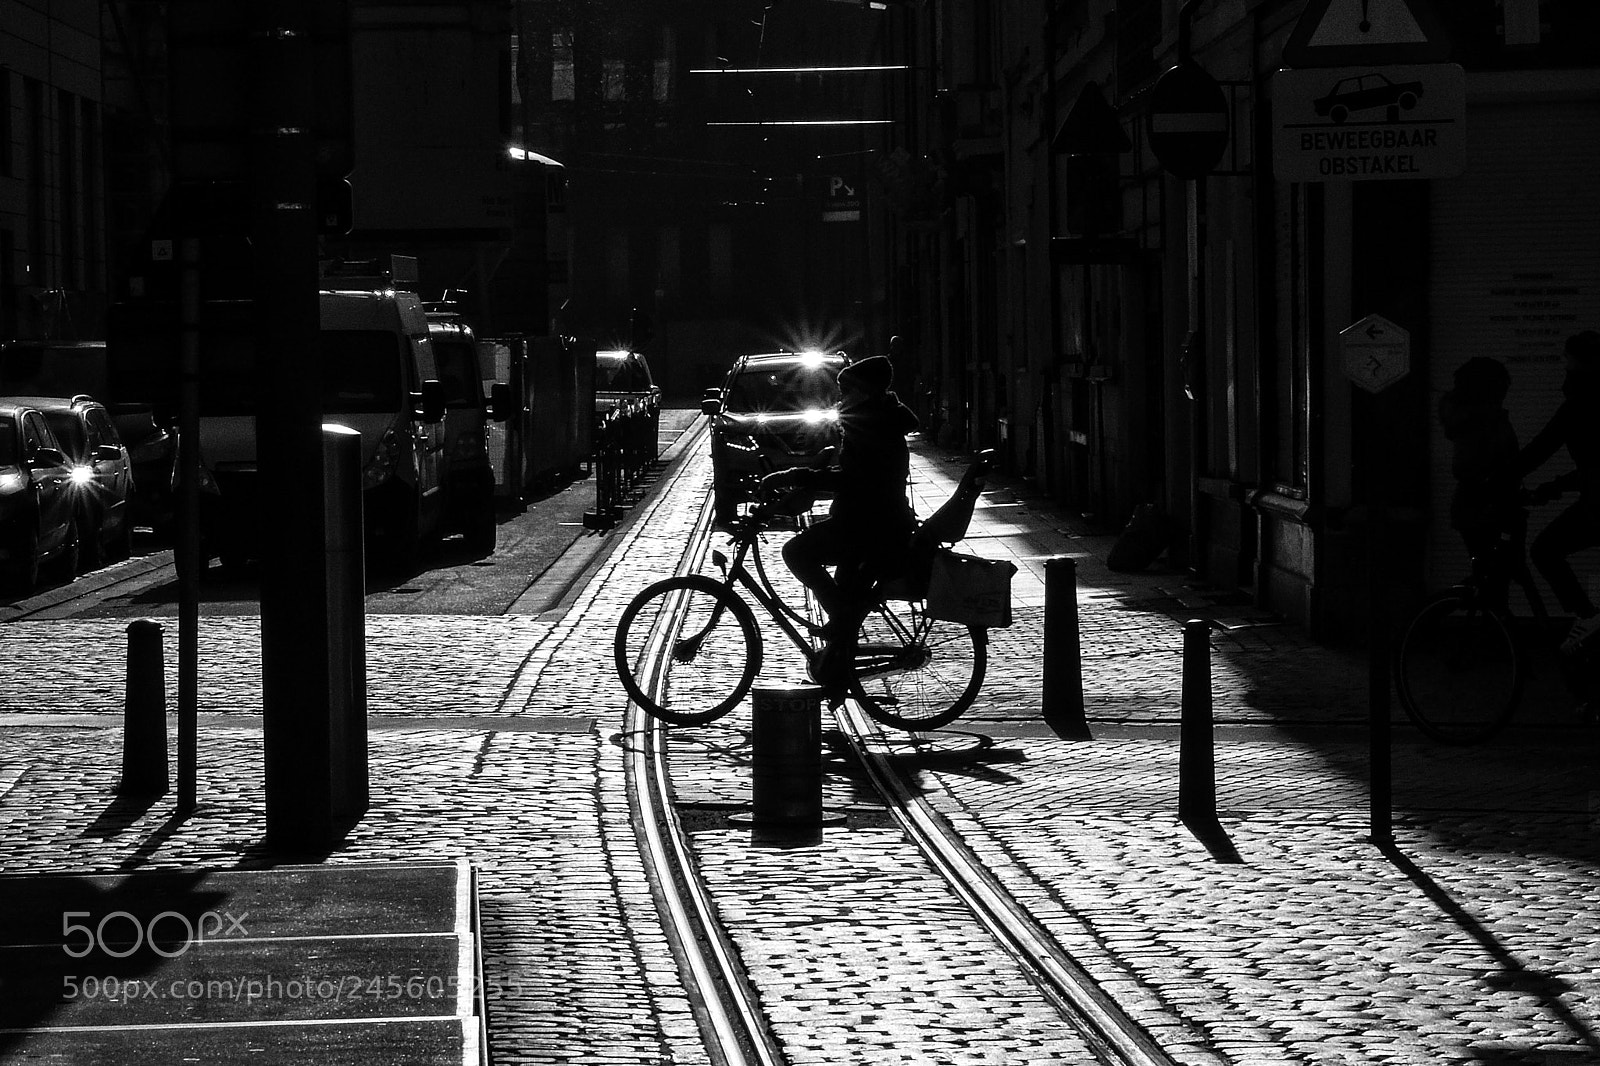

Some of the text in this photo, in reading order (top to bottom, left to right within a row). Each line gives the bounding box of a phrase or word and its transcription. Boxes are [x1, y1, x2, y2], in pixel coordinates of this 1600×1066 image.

[1300, 128, 1437, 151] BEWEEGBAAR
[1319, 155, 1419, 175] OBSTAKEL
[830, 176, 843, 196] P
[760, 698, 816, 711] STOP
